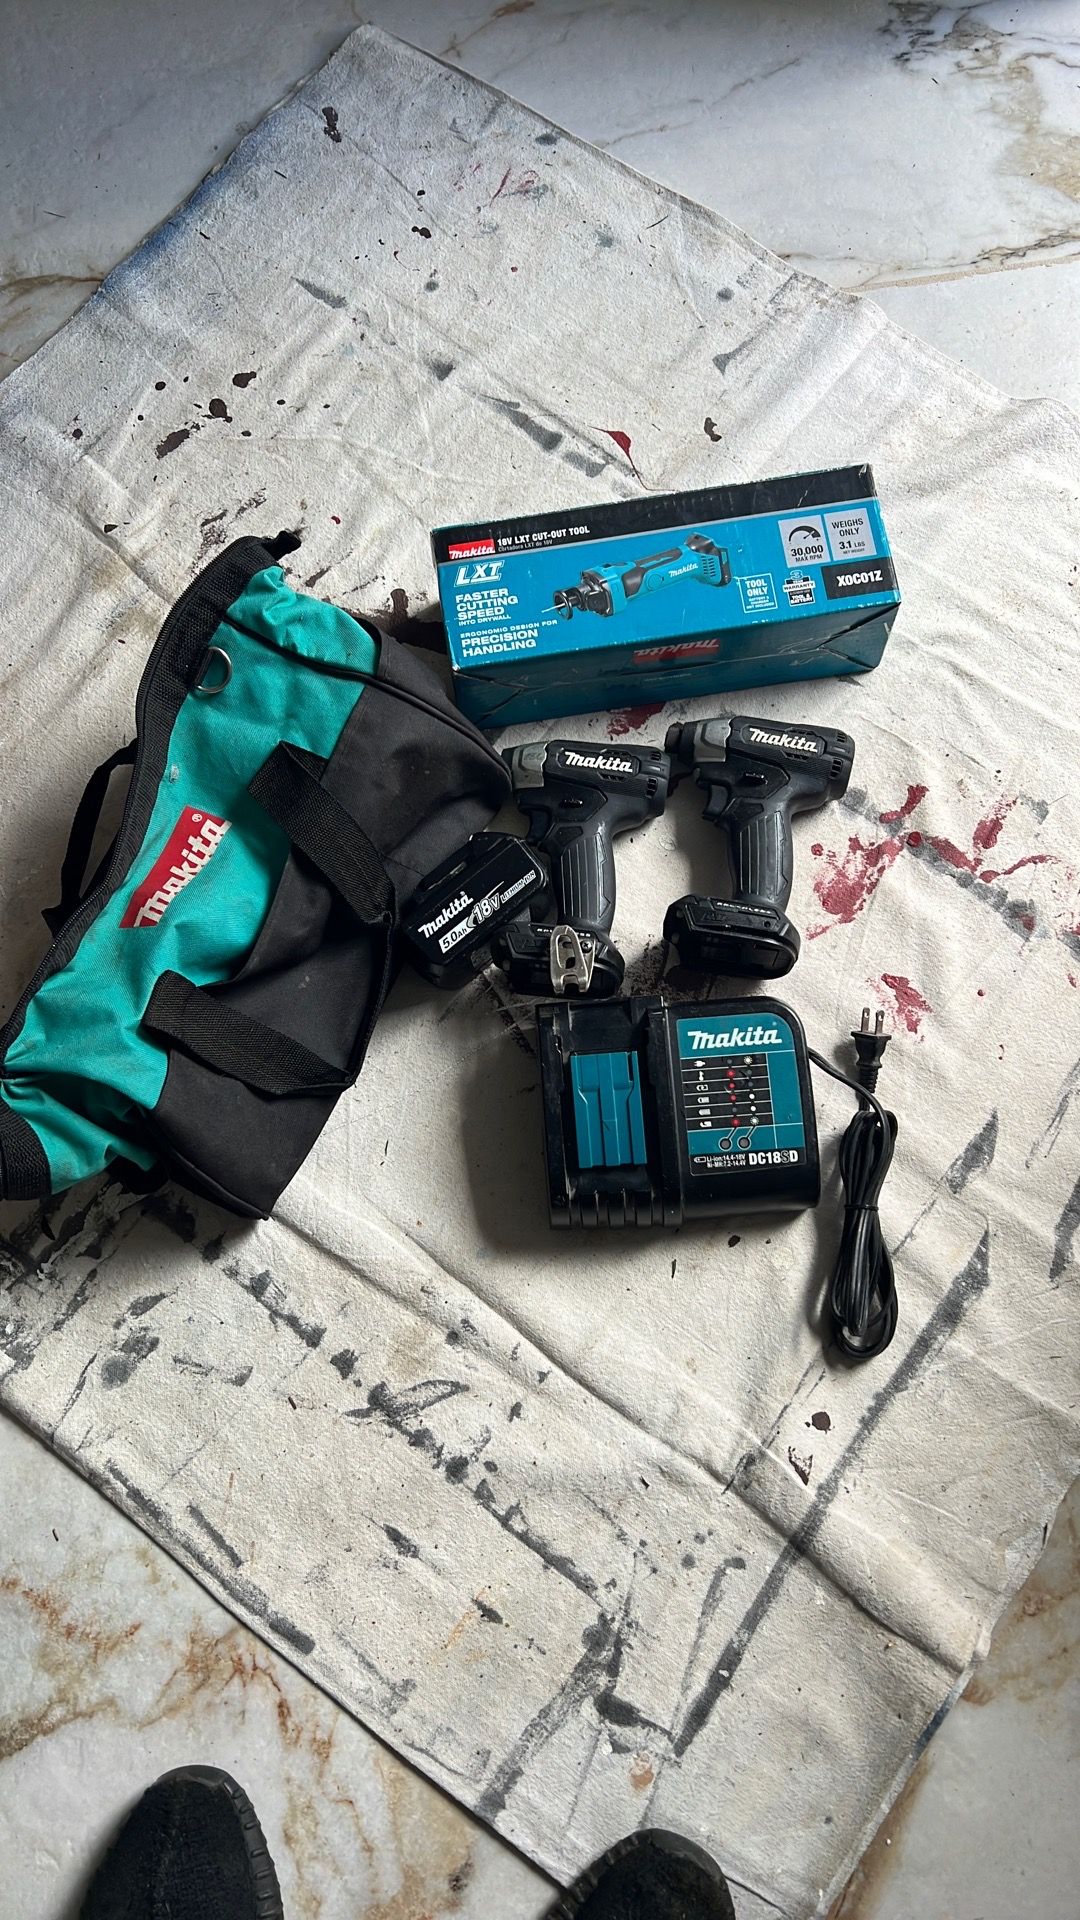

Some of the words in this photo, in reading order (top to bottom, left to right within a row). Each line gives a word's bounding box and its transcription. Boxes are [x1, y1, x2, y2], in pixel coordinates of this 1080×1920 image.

[831, 518, 864, 529] WEIGHS
[497, 537, 512, 546] 18V
[515, 535, 530, 544] LXT
[532, 529, 567, 541] CUT-OUT
[569, 526, 590, 535] TOOL
[839, 527, 860, 537] ONLY
[791, 545, 824, 557] 30,000
[839, 541, 852, 550] 3.1
[455, 560, 504, 587] LXT
[745, 579, 768, 588] TOOL
[455, 588, 508, 603] FASTER
[747, 587, 768, 597] ONLY
[456, 595, 518, 611] CUTTING
[457, 606, 505, 620] SPEED
[477, 614, 512, 624] DRYWALL
[460, 627, 508, 638] ERGONOMIC
[510, 623, 539, 632] DESIGN
[461, 629, 538, 648] PRECISION
[463, 639, 537, 657] HANDLING
[442, 927, 468, 949] 5.0Ah
[748, 1150, 799, 1165] DC18SD
